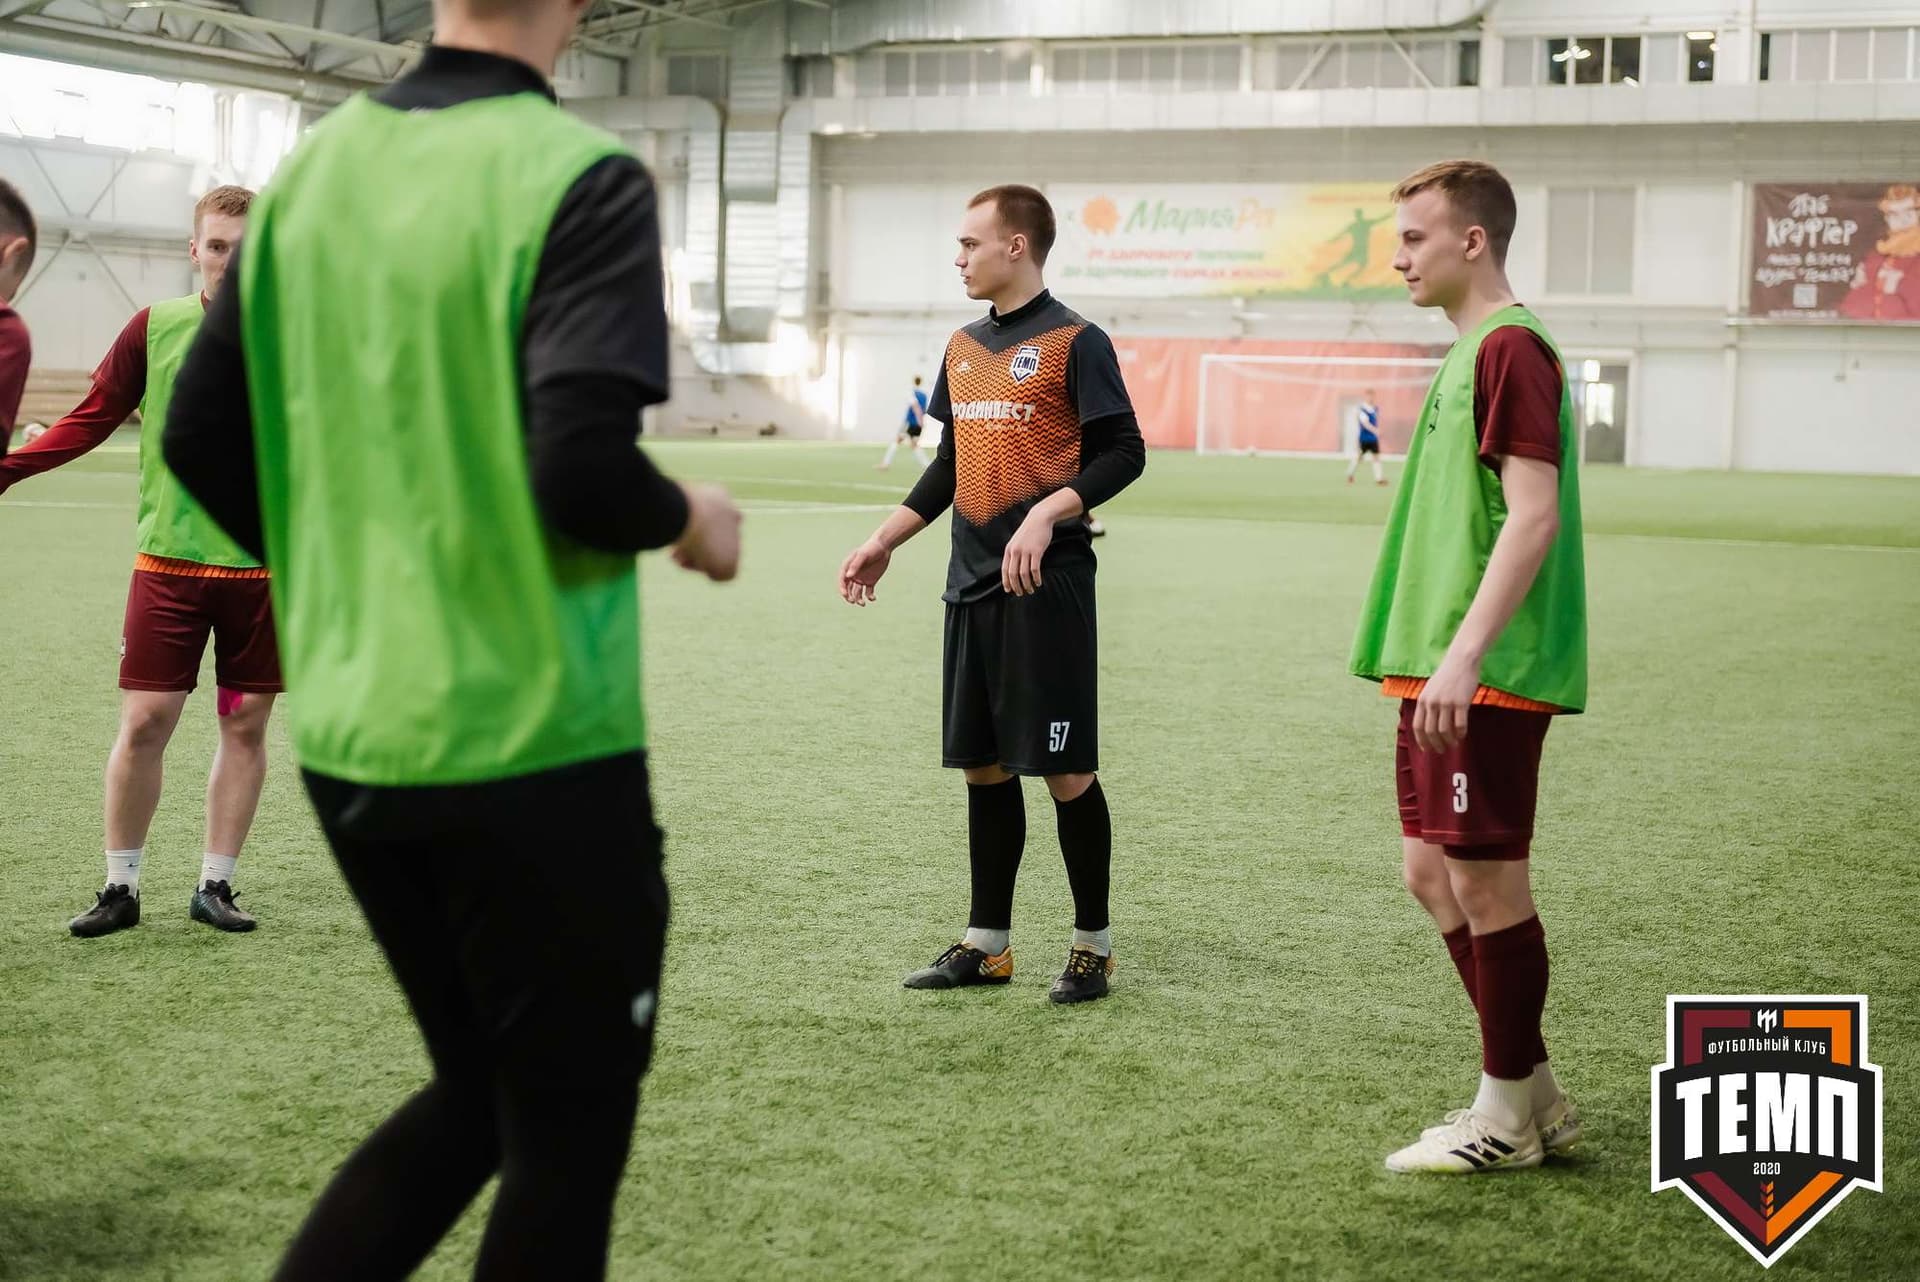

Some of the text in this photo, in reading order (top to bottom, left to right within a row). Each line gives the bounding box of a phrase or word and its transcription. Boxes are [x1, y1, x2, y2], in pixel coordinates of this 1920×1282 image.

[1013, 356, 1037, 371] ТЕМП
[1049, 721, 1070, 752] 57
[1452, 772, 1468, 813] 3
